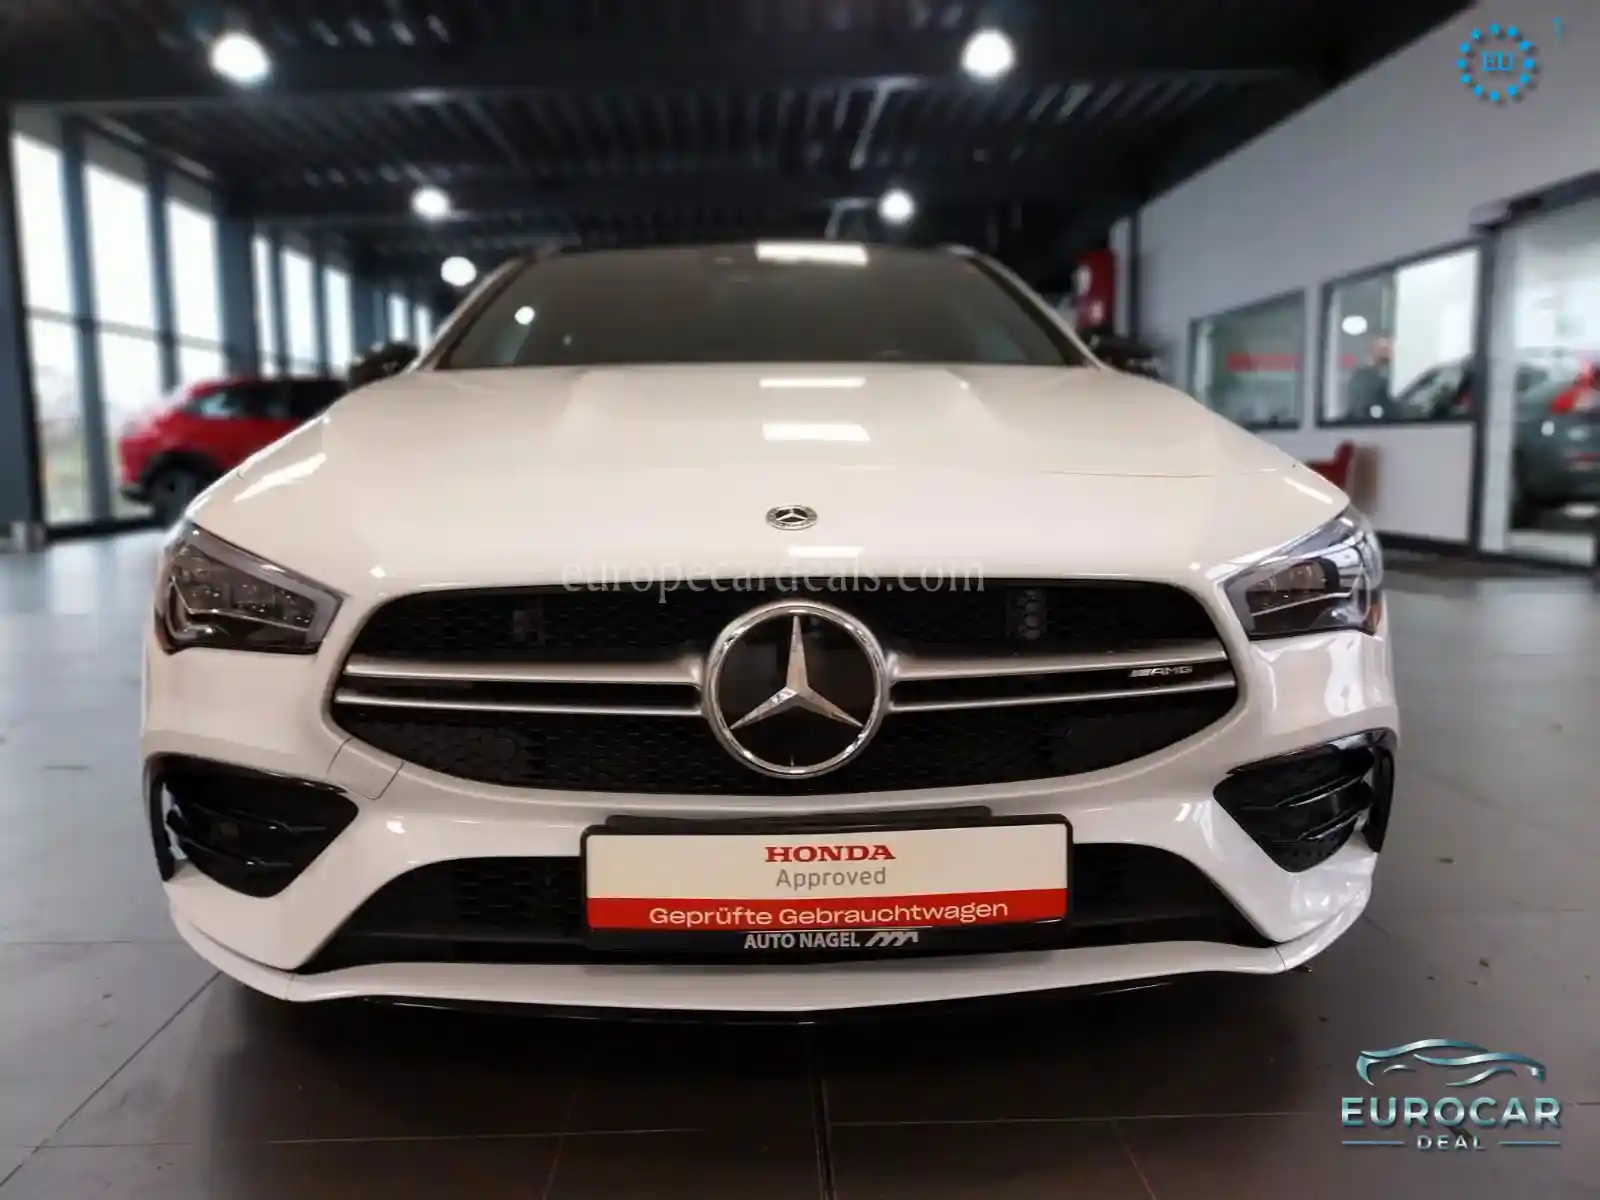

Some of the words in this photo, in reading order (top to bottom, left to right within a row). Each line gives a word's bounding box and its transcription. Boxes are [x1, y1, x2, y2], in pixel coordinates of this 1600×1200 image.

[765, 845, 896, 862] HONDA
[776, 867, 886, 890] Approved
[650, 907, 772, 928] Geprüfte
[779, 902, 1008, 925] Gebrauchtwagen
[744, 933, 795, 949] AUTO
[800, 931, 861, 948] NAGEL
